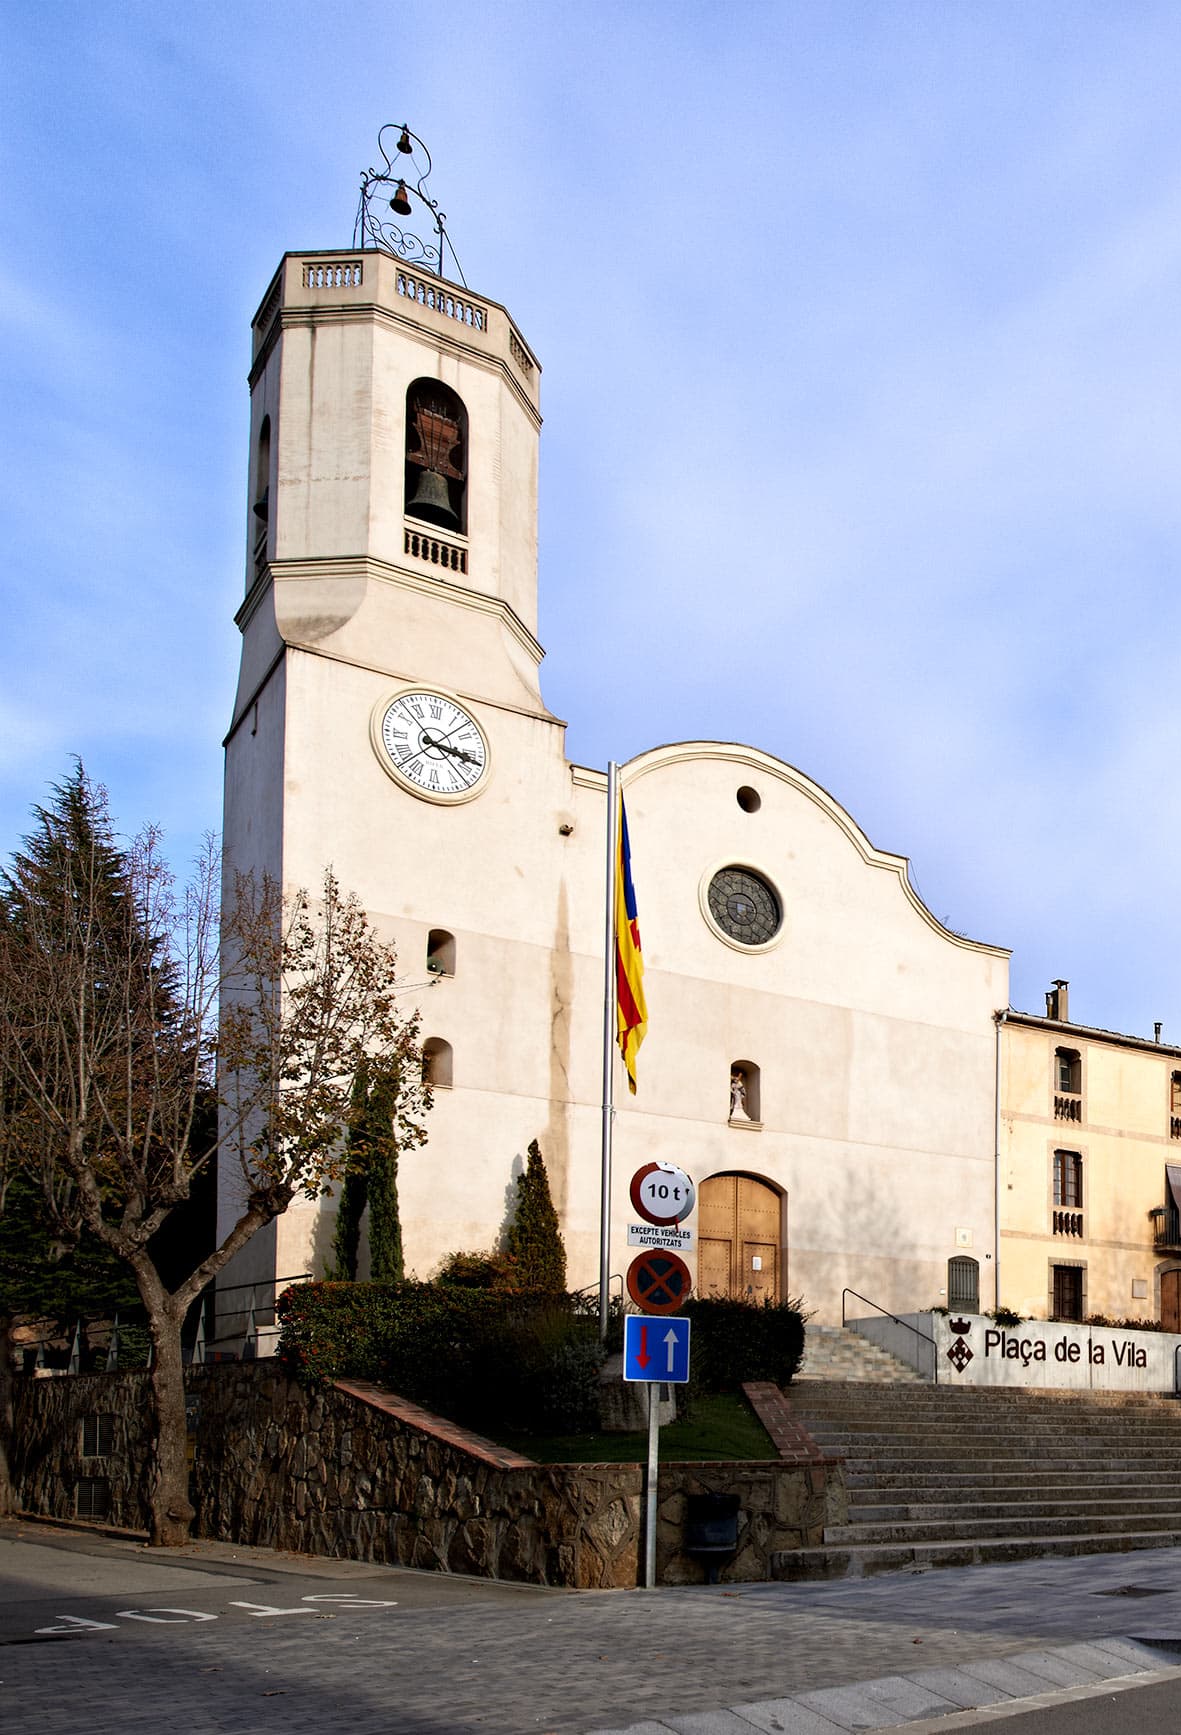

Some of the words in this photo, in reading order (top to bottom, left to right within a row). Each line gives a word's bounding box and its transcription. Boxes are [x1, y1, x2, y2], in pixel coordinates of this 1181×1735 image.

[429, 704, 443, 720] XII
[648, 1183, 669, 1200] 10
[673, 1186, 681, 1201] t
[631, 1226, 660, 1236] EXCEPTE
[639, 1236, 682, 1248] AUTORITZATS
[984, 1329, 1046, 1367] Plaça
[1054, 1335, 1081, 1363] de
[1088, 1338, 1104, 1365] la
[1111, 1340, 1147, 1368] Vila
[34, 1593, 398, 1634] STOP
